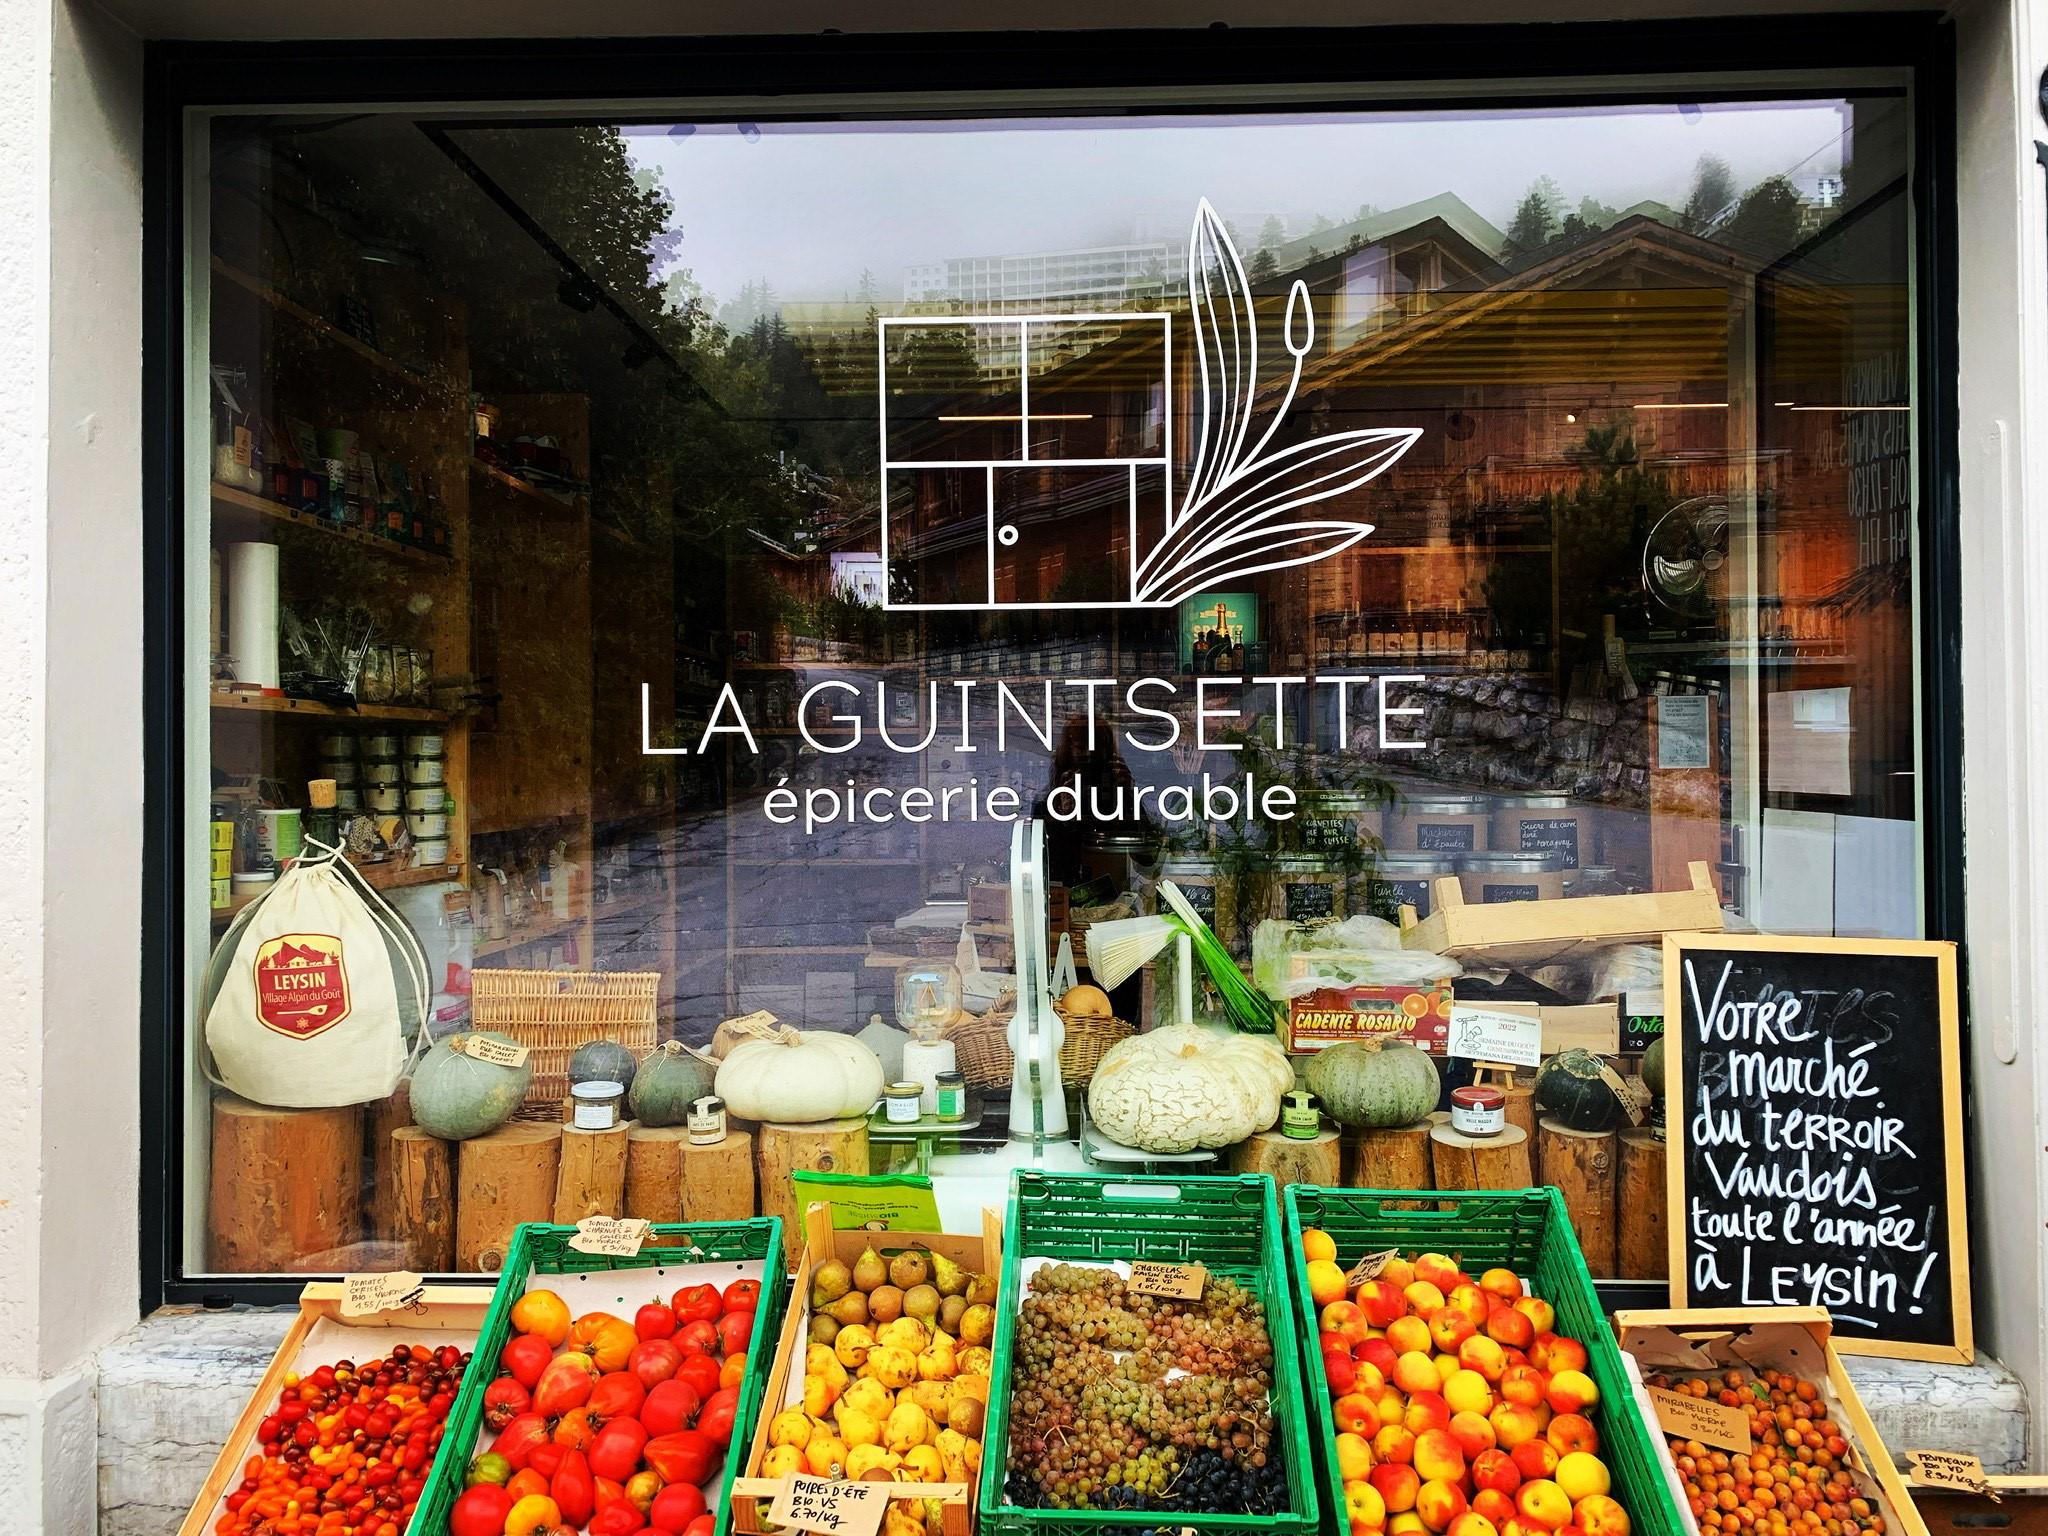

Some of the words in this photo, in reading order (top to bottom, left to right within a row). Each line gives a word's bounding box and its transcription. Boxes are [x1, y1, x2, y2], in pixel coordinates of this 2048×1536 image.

[641, 682, 759, 755] LA
[797, 675, 1427, 754] GUINTSETTE
[763, 776, 1020, 834] épicerie
[1046, 772, 1297, 823] durable
[262, 992, 287, 1005] Village
[288, 991, 309, 1004] Alpin
[309, 991, 321, 1000] du
[321, 988, 341, 999] Goût
[274, 972, 326, 990] LEYSIN
[1295, 1013, 1354, 1030] CADENTE
[1356, 1014, 1417, 1031] ROSARIO
[1728, 1036, 1880, 1099] marché
[1692, 1084, 1751, 1149] du
[1705, 1150, 1878, 1210] Vaudois
[1691, 1196, 1776, 1240] toute
[350, 1275, 388, 1287] TOMATES
[1694, 1239, 1732, 1291] à
[1656, 1395, 1720, 1417] MIRABELLES
[1917, 1453, 1976, 1468] PRUNEAUX
[793, 1480, 828, 1496] POIRES
